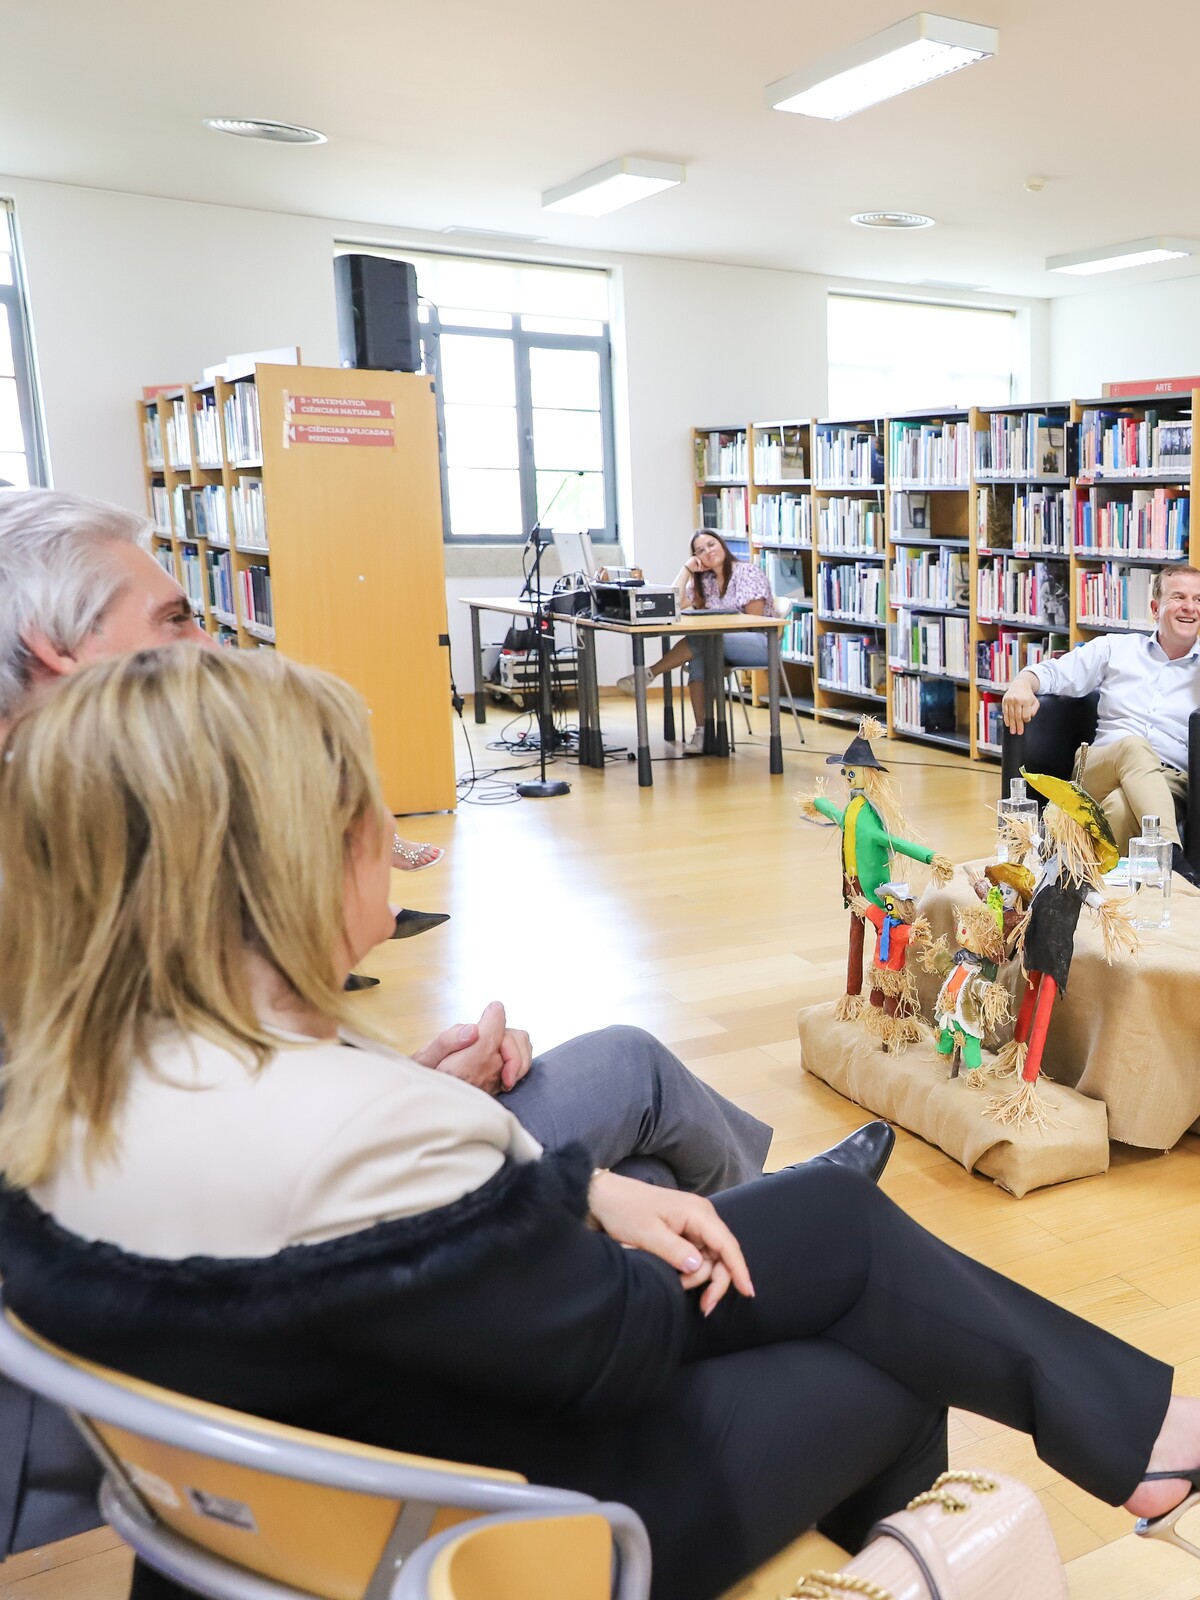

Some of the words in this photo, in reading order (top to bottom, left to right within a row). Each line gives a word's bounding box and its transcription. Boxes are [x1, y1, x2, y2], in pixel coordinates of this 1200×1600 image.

[1154, 382, 1173, 391] ARTE
[311, 397, 366, 407] MATEMÁTICA
[300, 405, 340, 415] CIÊNCIAS
[340, 408, 381, 417] NATURAIS
[346, 427, 390, 436] APLICADAS
[308, 435, 350, 443] MEDICINA
